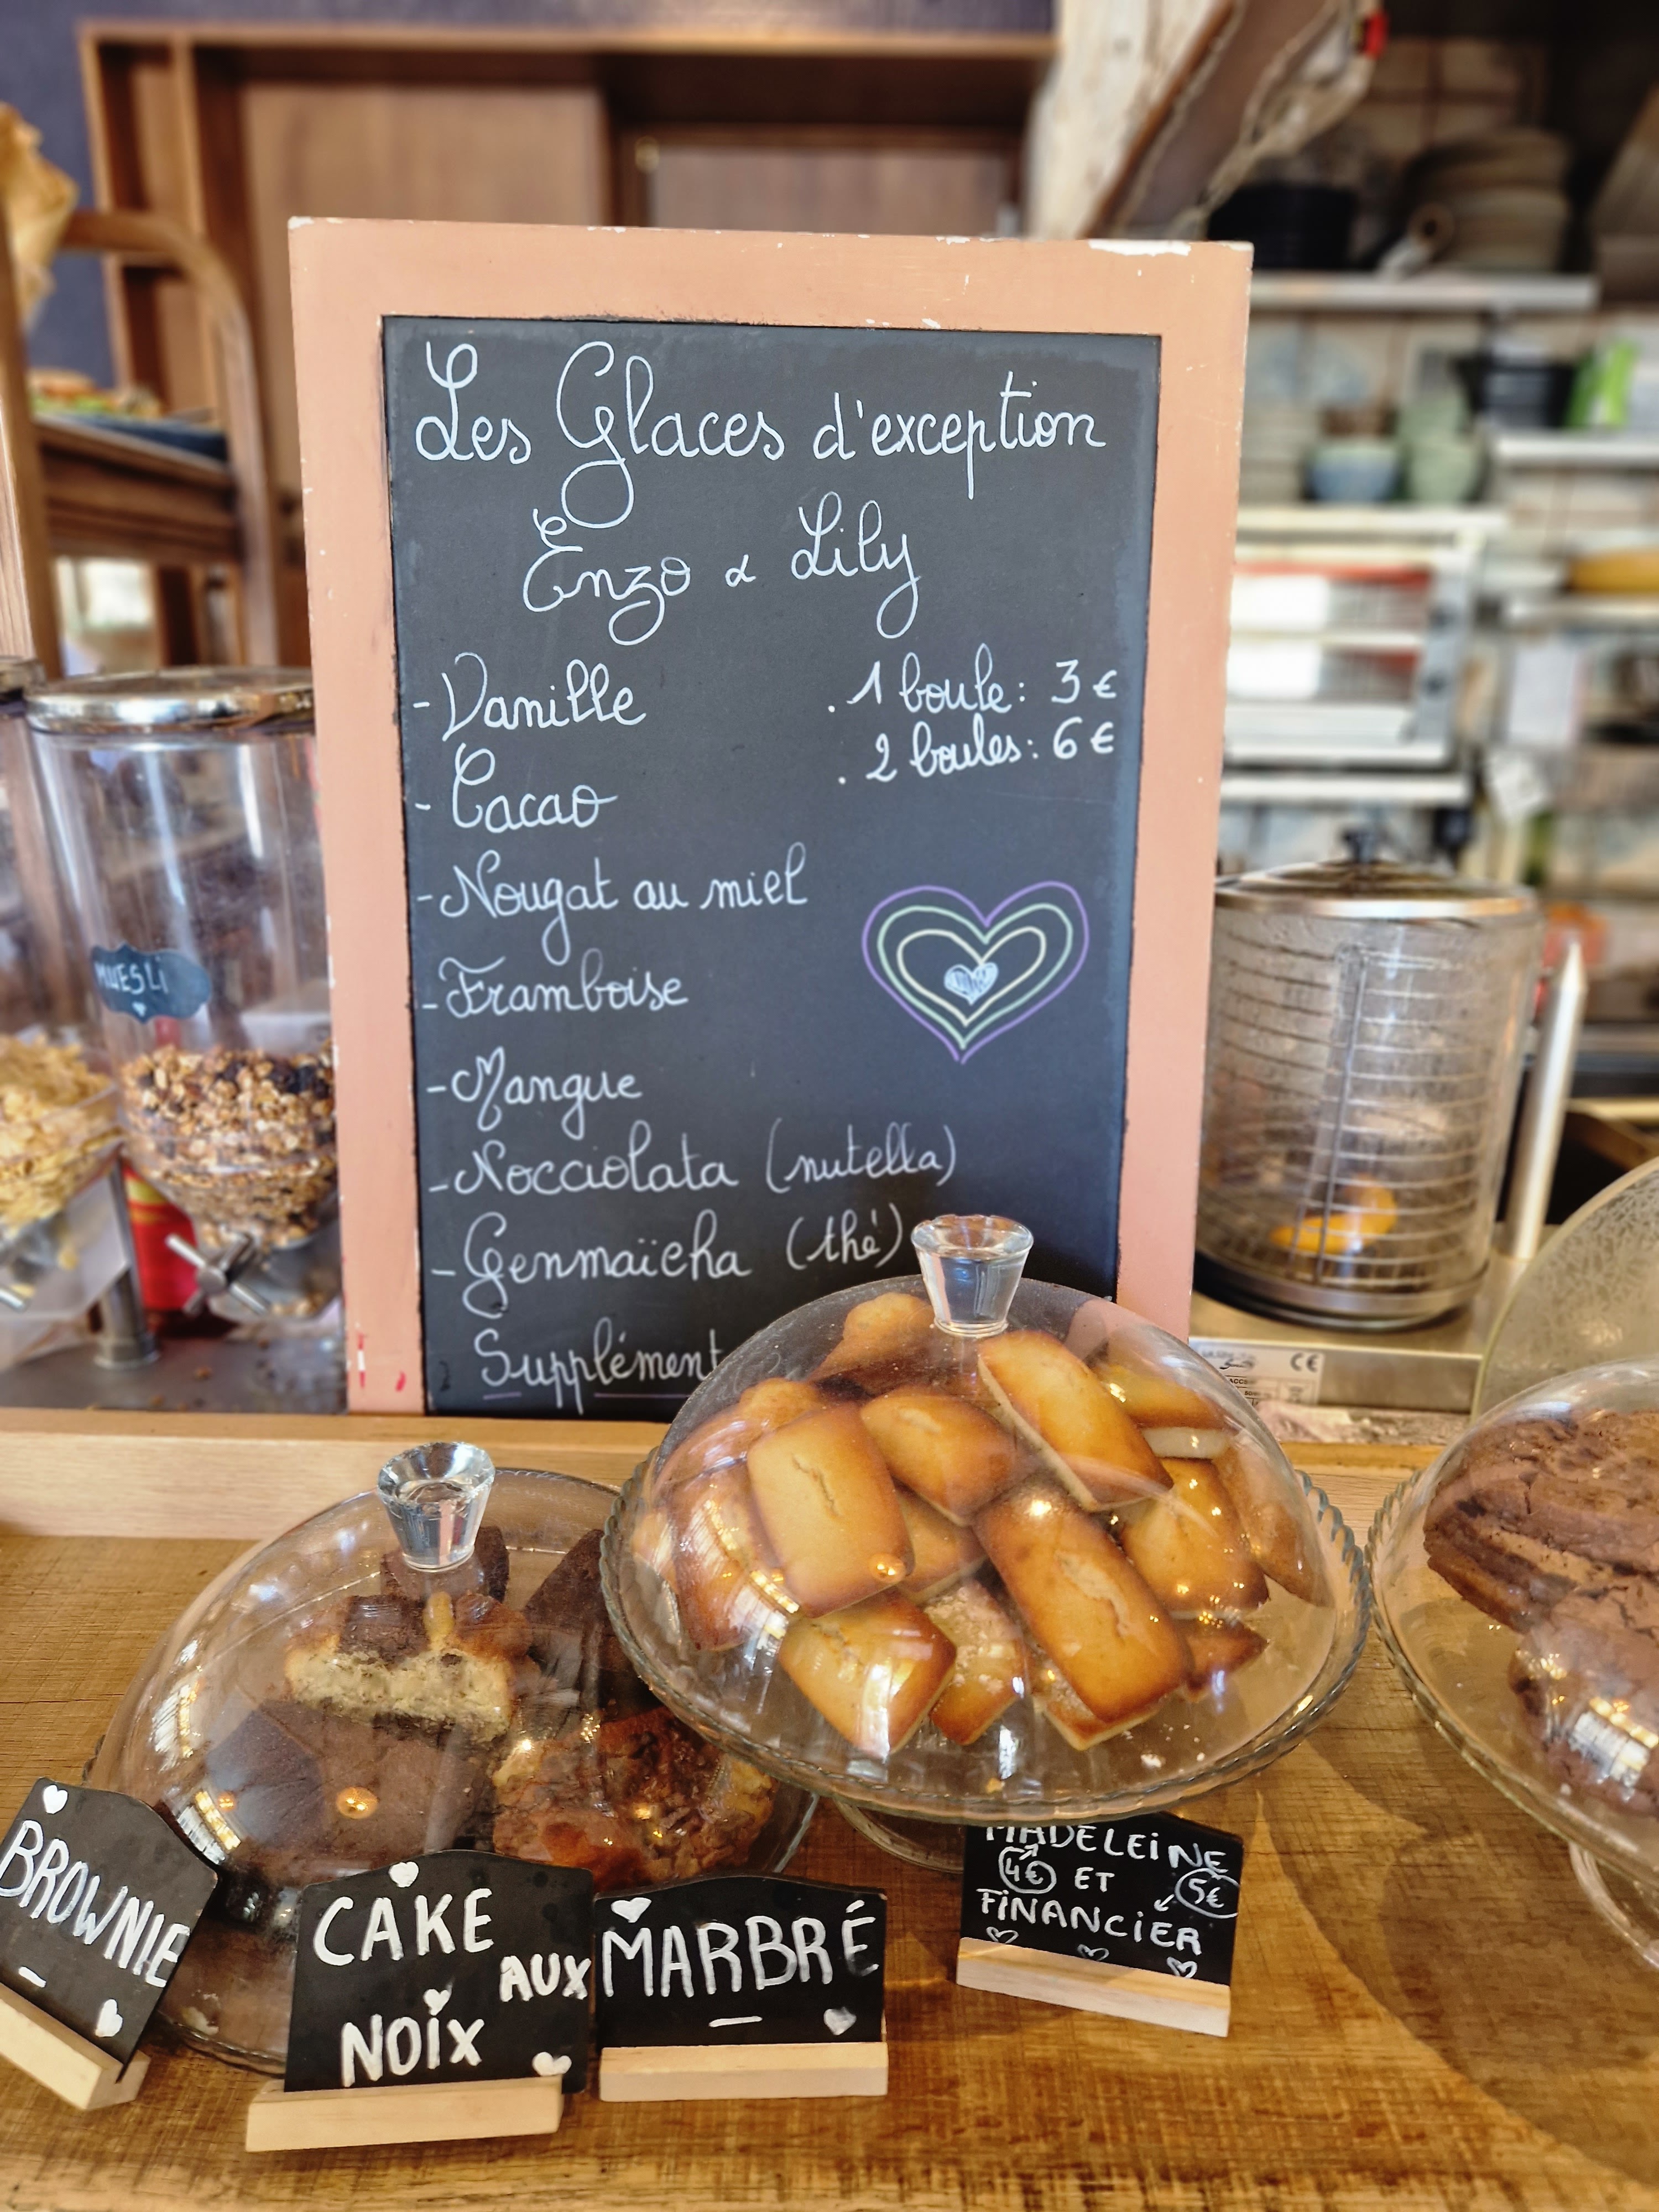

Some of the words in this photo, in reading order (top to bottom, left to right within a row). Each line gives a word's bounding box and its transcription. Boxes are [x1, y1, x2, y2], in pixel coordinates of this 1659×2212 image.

[415, 341, 531, 465] Les
[556, 341, 785, 529] Glaces
[813, 371, 1107, 500] d'exception
[523, 508, 691, 646] Enzo
[791, 491, 922, 639] Lily
[441, 652, 647, 742] Vanille
[846, 660, 881, 705] 1
[452, 743, 618, 833] Cacao
[866, 733, 898, 782] 2
[440, 849, 619, 966] Nougat
[633, 880, 690, 910] au
[699, 842, 808, 910] miel
[439, 948, 689, 1019] Framboise
[451, 1046, 643, 1141] Mangue
[766, 1117, 956, 1193] (nutella)
[786, 1203, 903, 1271] (thé)
[0, 1819, 191, 1987] BROWNIE
[1074, 1867, 1115, 1892] ET
[312, 1887, 495, 1966] CAKE
[602, 1899, 879, 1998] MARBRÉ
[499, 1952, 592, 2002] AUX
